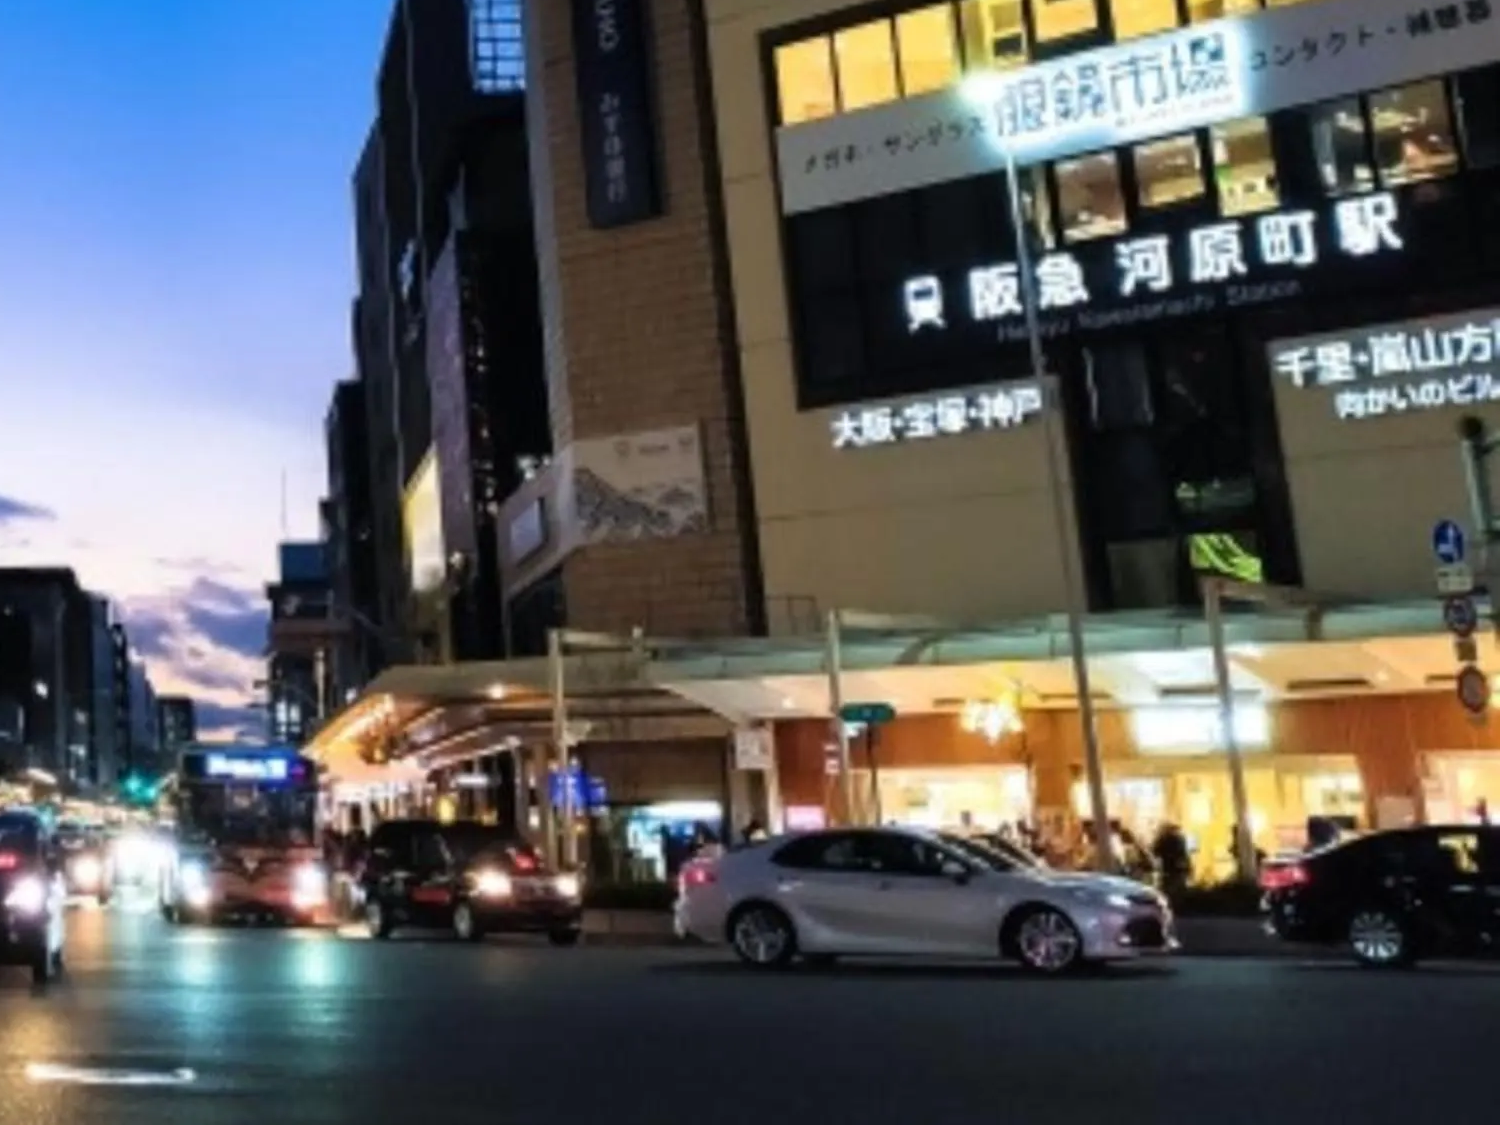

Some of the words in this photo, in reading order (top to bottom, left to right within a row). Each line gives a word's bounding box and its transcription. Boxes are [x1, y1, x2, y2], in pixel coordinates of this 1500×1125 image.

[1274, 318, 1500, 388] 千里・嵐山方
[831, 387, 1042, 448] 大阪・宝塚・神戸
